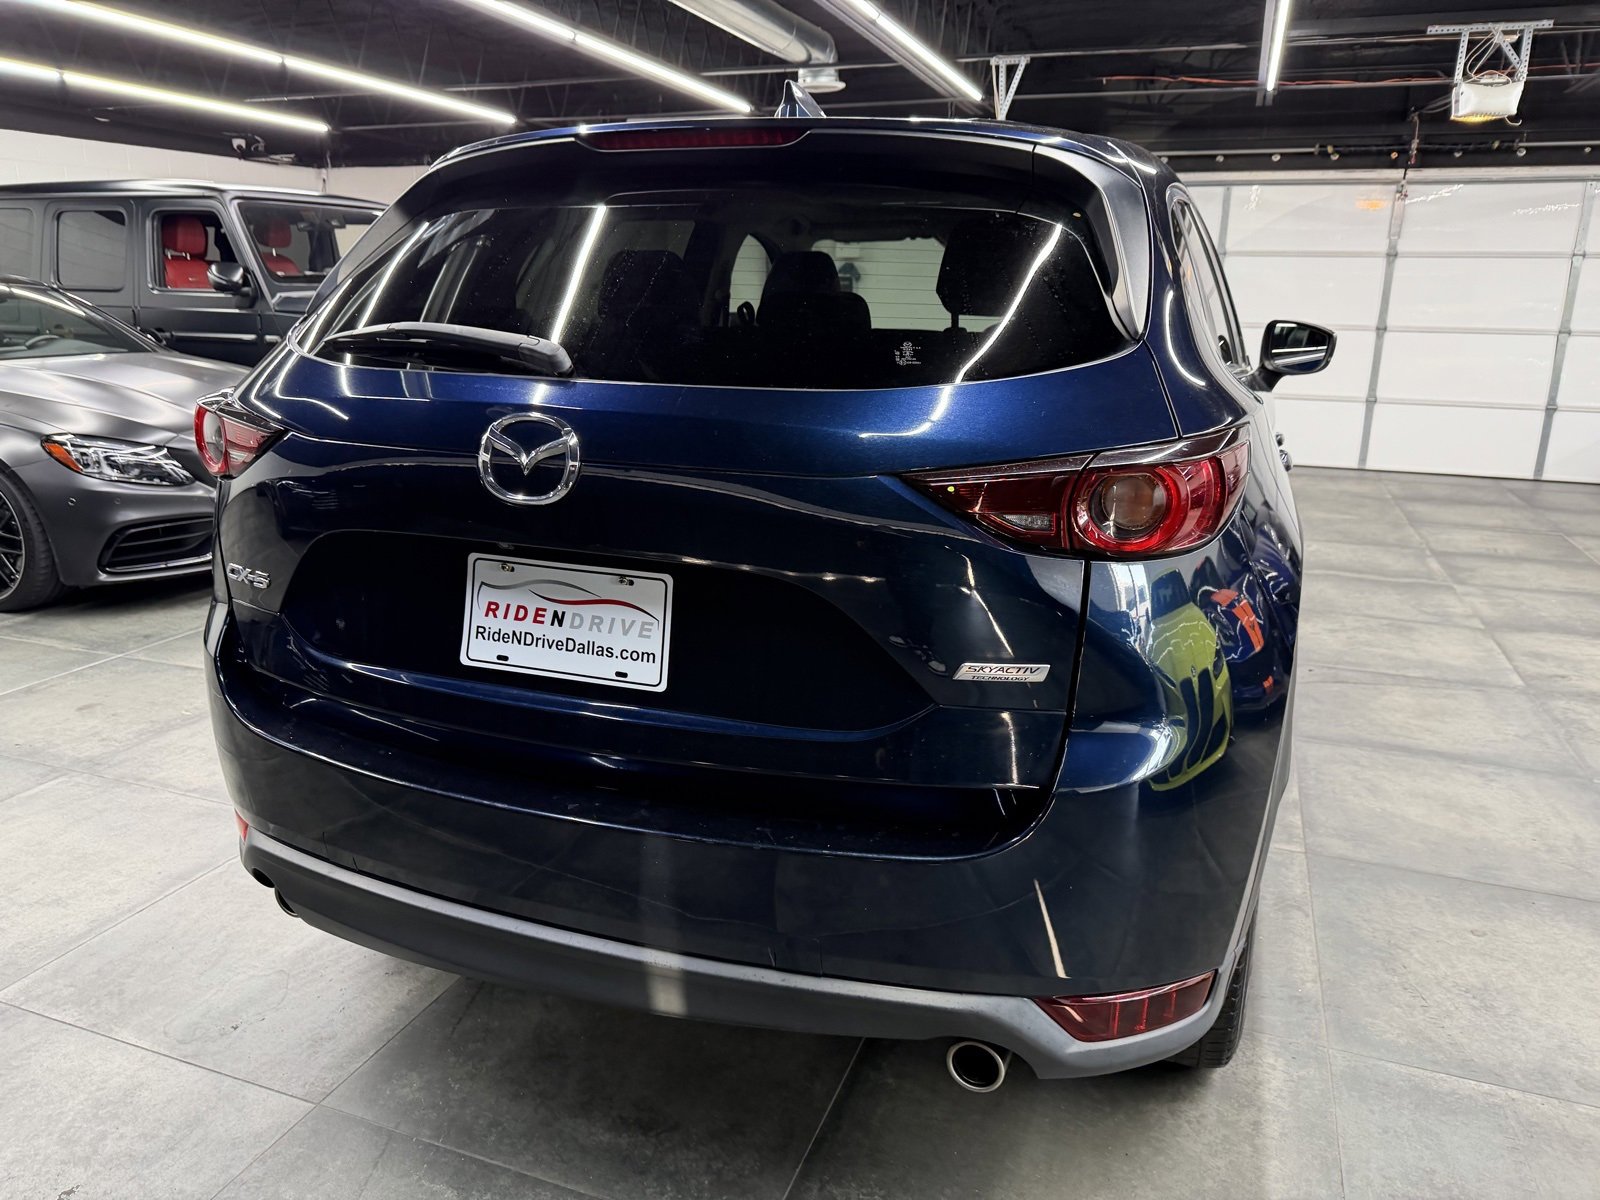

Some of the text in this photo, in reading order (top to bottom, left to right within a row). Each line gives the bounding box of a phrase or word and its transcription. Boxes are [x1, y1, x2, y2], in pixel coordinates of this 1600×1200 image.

[227, 562, 270, 589] CX-5
[475, 625, 656, 664] RideNDriveDallas.com
[965, 665, 1040, 675] SKYACTIV
